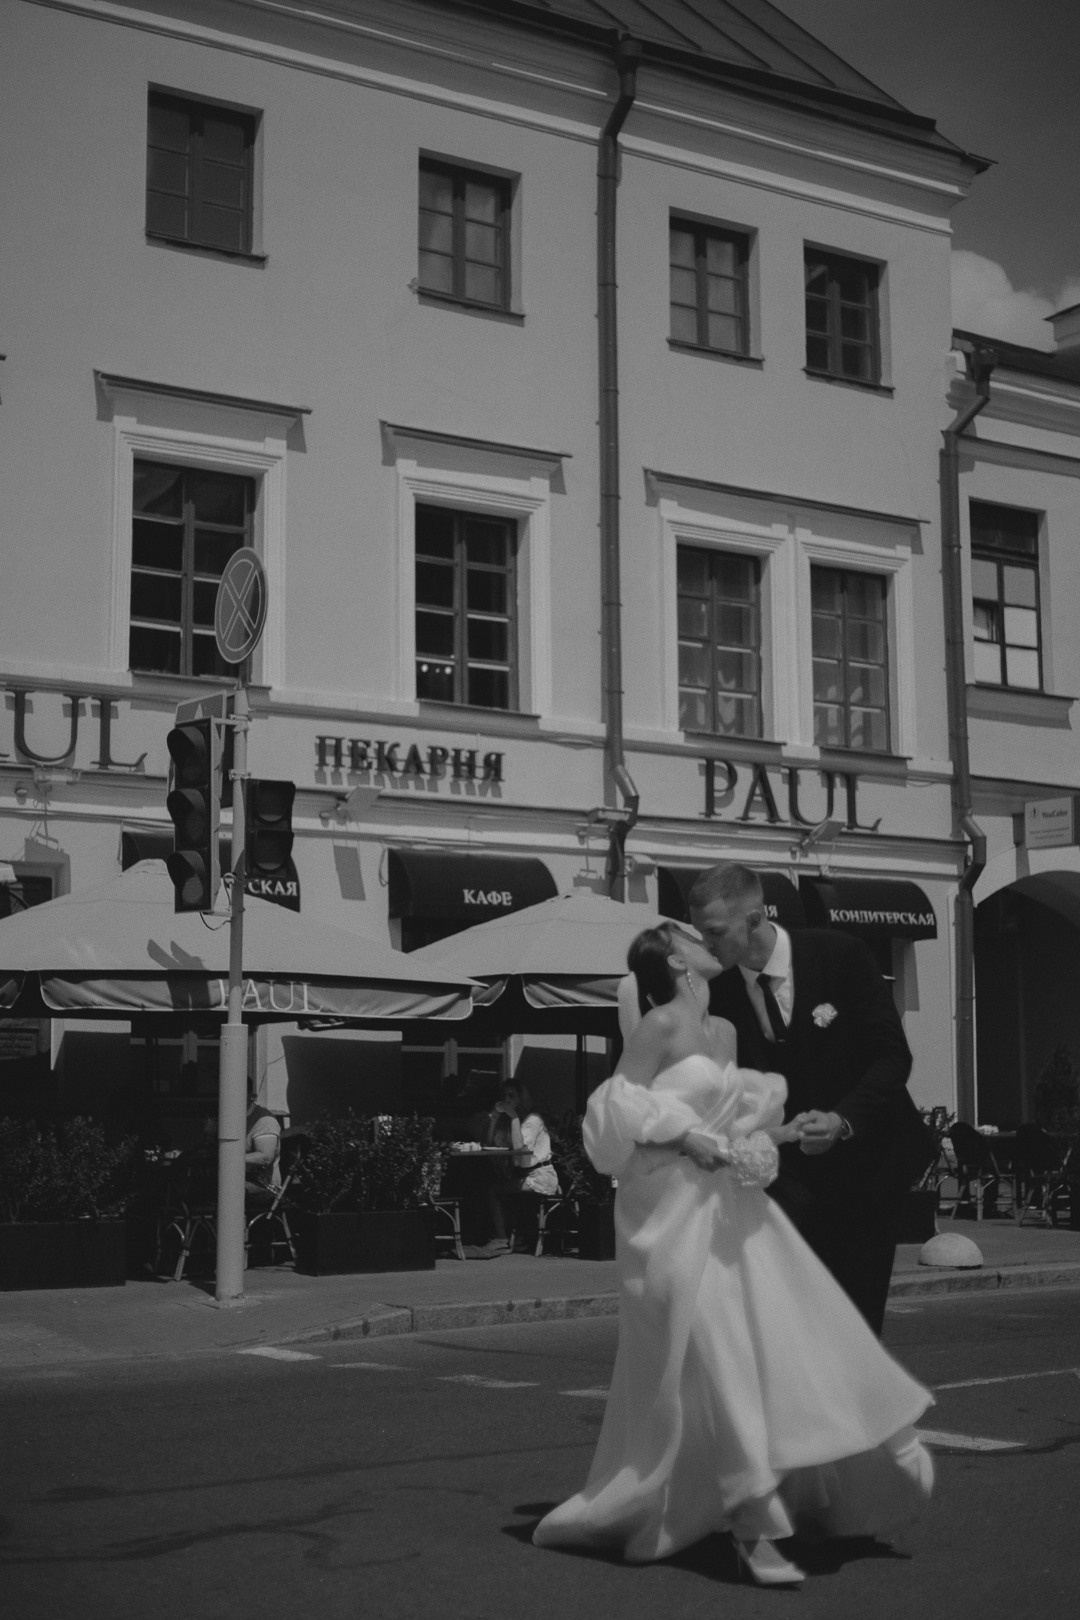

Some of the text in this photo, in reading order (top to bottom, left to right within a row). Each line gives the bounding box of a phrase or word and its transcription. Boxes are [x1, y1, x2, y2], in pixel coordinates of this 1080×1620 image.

[0, 688, 148, 768] UL
[314, 735, 505, 782] ПЕКАРНЯ
[697, 757, 881, 832] PAUL
[246, 878, 298, 897] СКАЯ
[462, 888, 513, 906] КАФЕ
[829, 908, 935, 926] КОНДИТЕРСКАЯ
